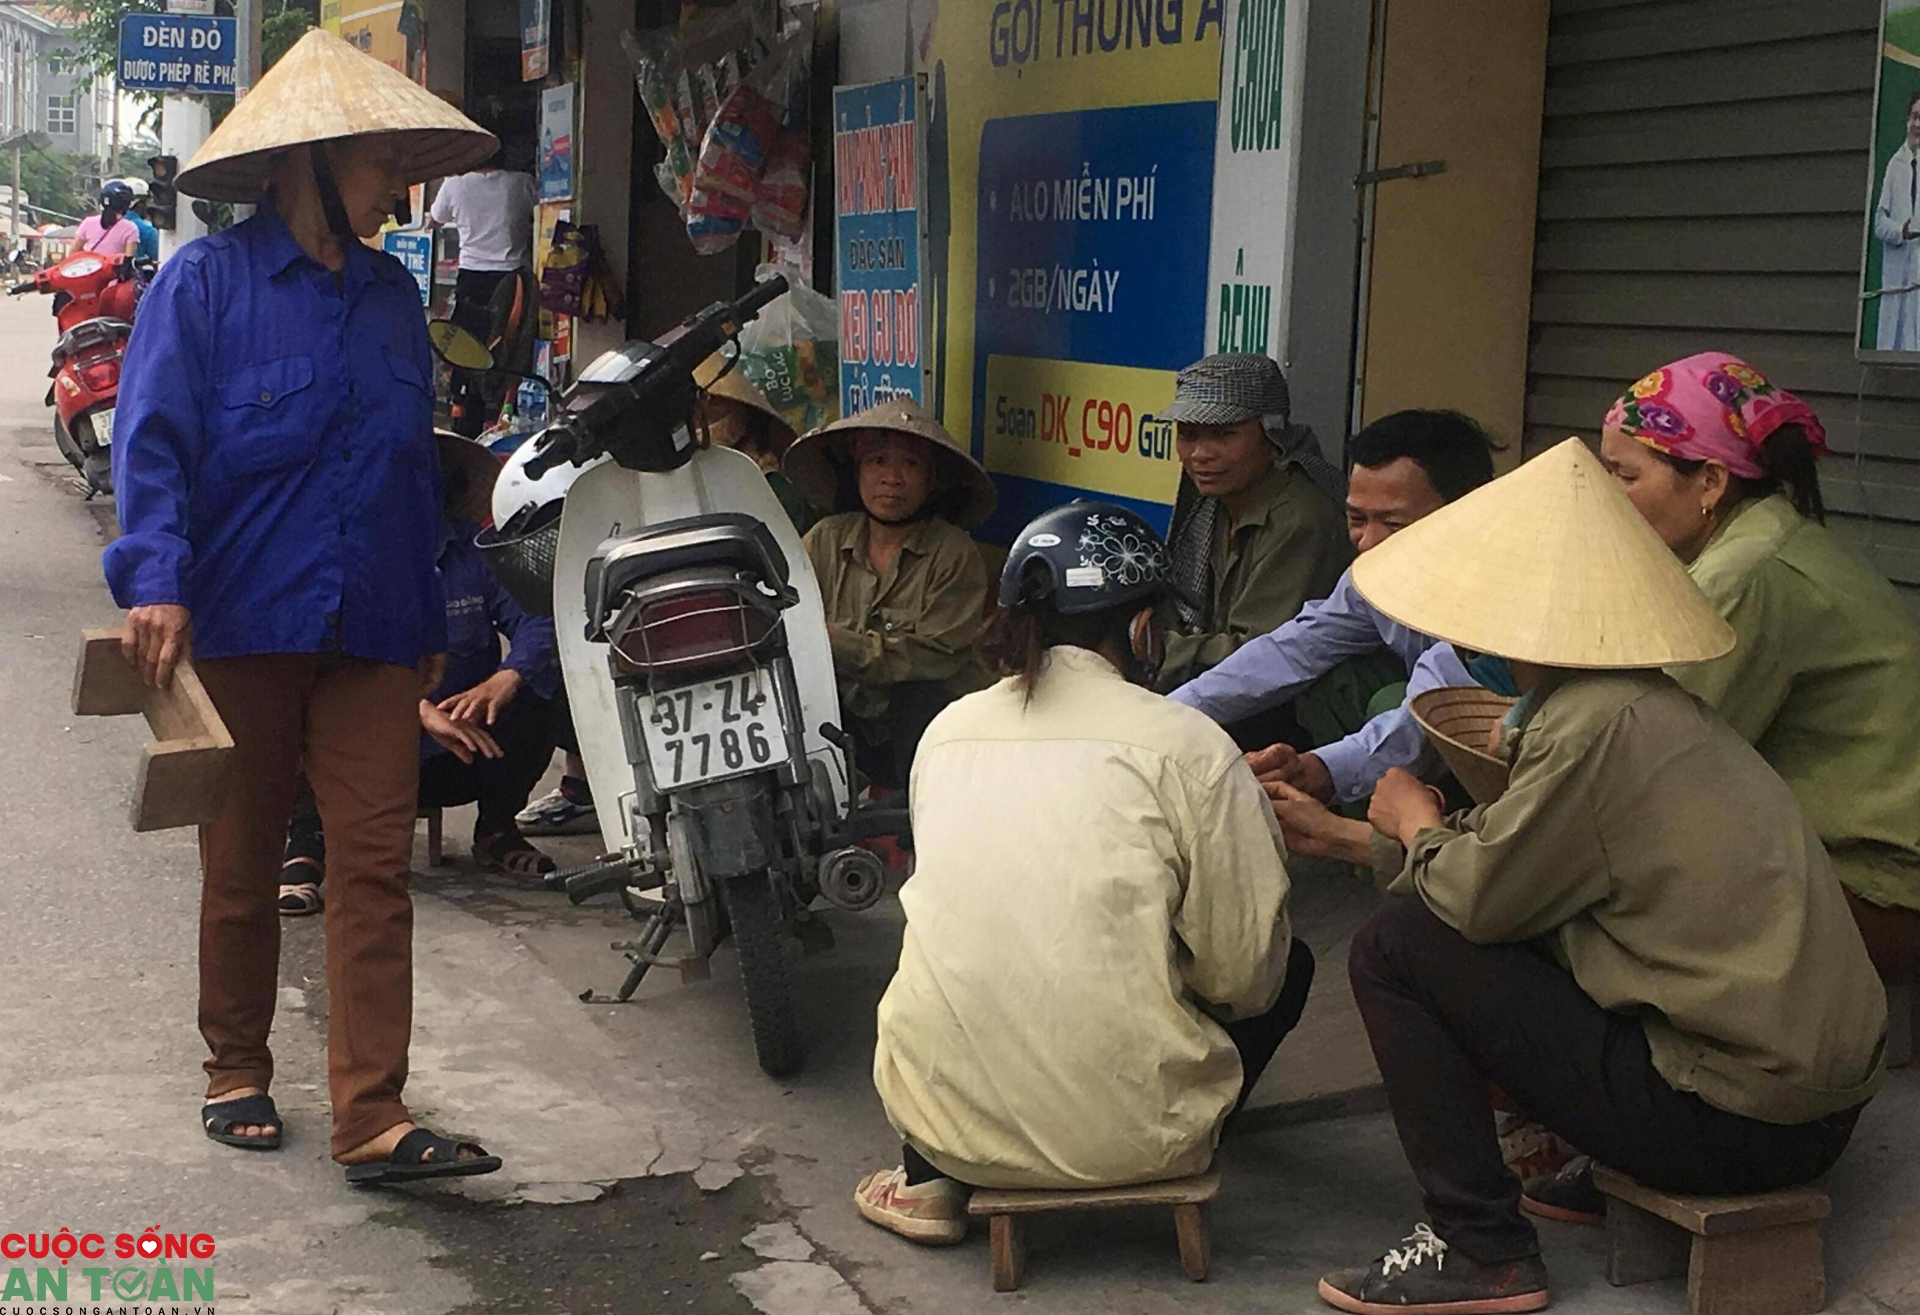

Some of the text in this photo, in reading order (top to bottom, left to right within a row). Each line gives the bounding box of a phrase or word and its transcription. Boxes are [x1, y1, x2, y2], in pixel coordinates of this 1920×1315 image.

[143, 20, 221, 50] ĐÈN ĐỎ
[159, 56, 191, 83] PHÉP
[1010, 162, 1158, 221] ALO MIỄN PHÍ
[1009, 258, 1120, 314] 2GB/NGÀY
[996, 395, 1036, 446] Soạn
[1041, 393, 1132, 457] DK_C90
[656, 677, 767, 736] 37-Z4
[665, 722, 771, 783] 7786
